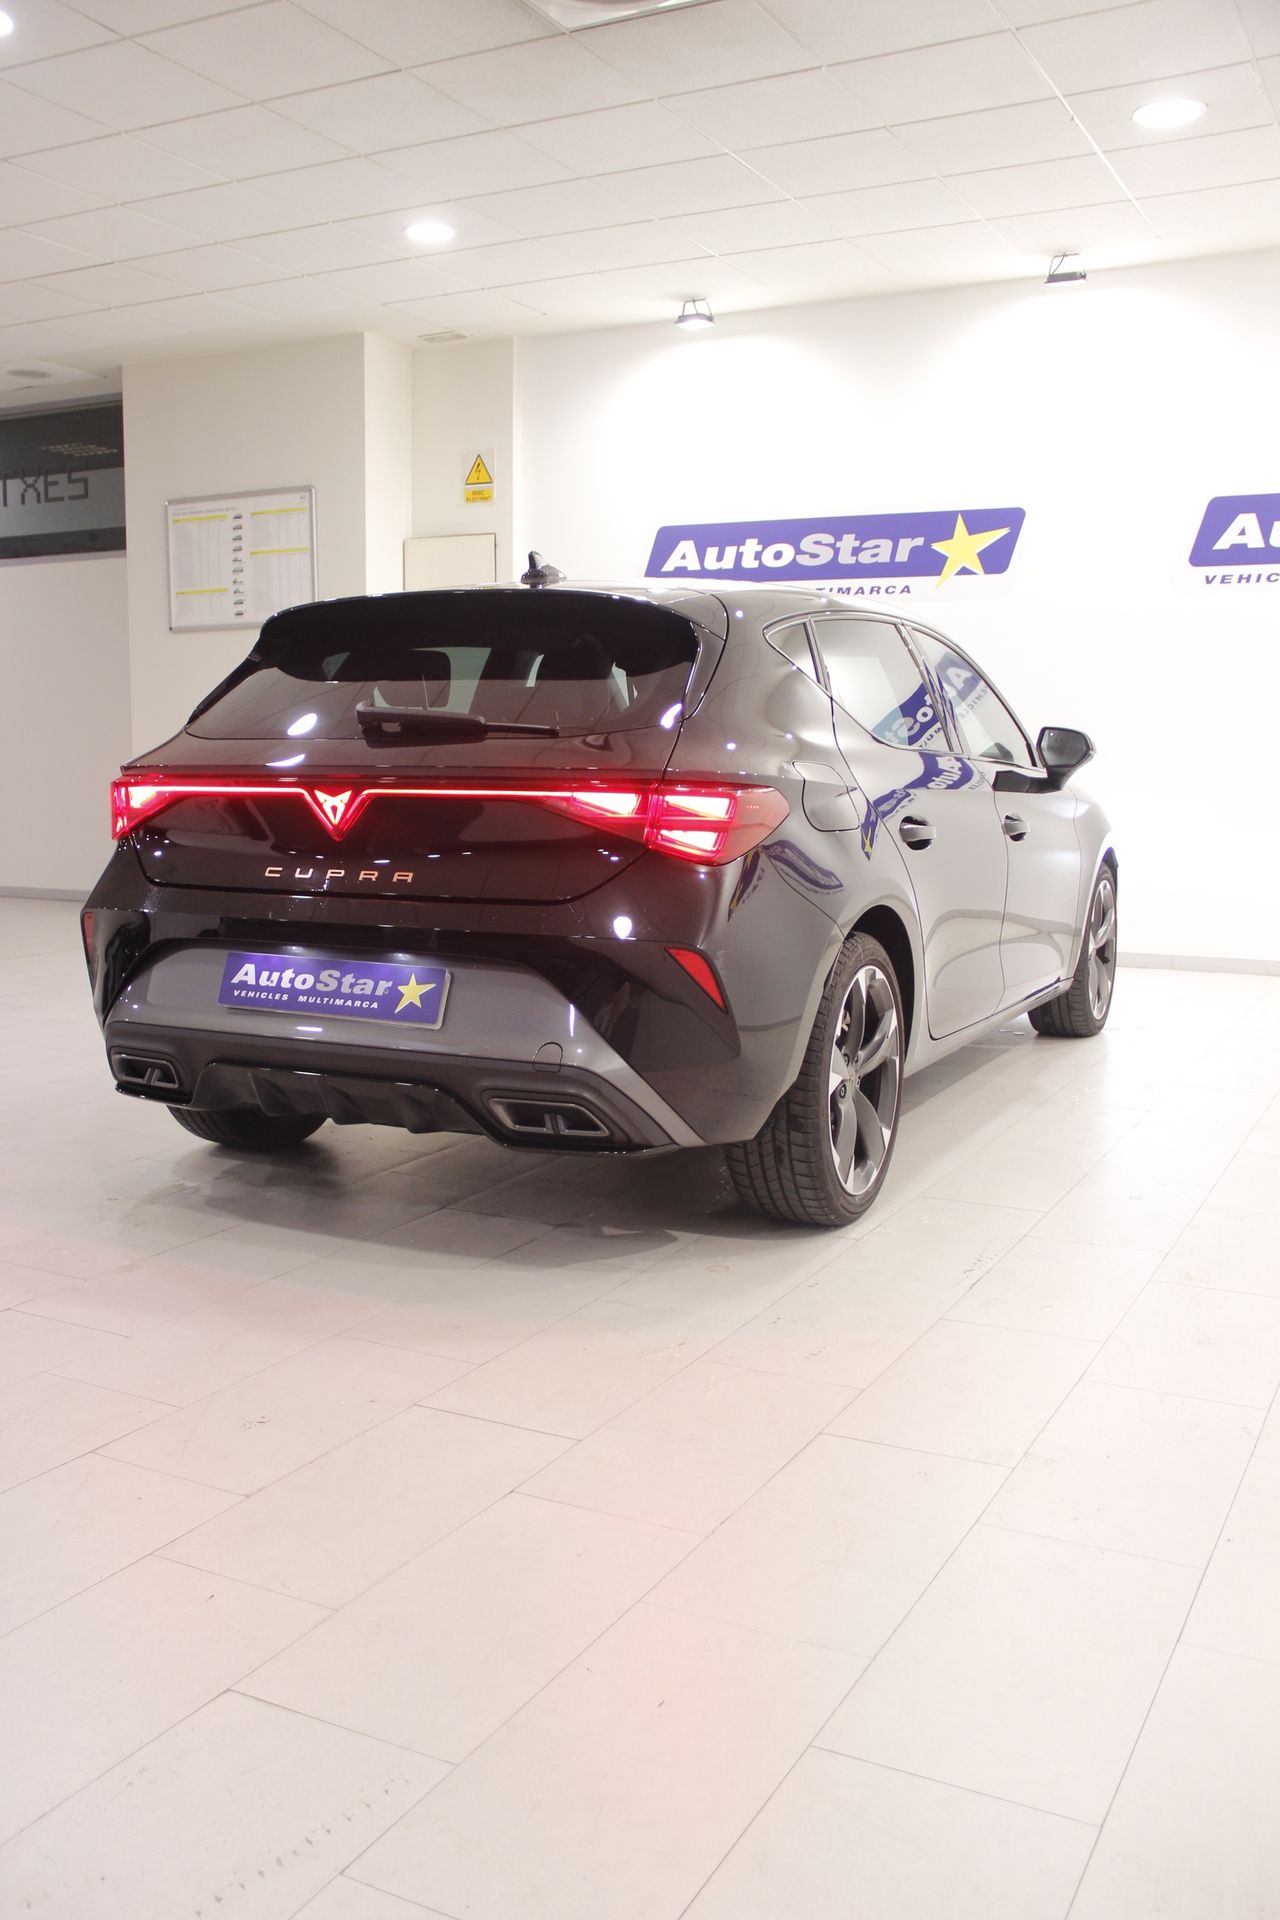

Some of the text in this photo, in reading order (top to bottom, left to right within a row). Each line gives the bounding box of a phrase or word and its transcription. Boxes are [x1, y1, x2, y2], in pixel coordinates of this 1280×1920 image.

[661, 533, 925, 572] AutoStar
[264, 867, 414, 883] CUPRA
[231, 963, 394, 997] AutoStar
[233, 990, 379, 1009] VEHICLES MULTIMARCA
